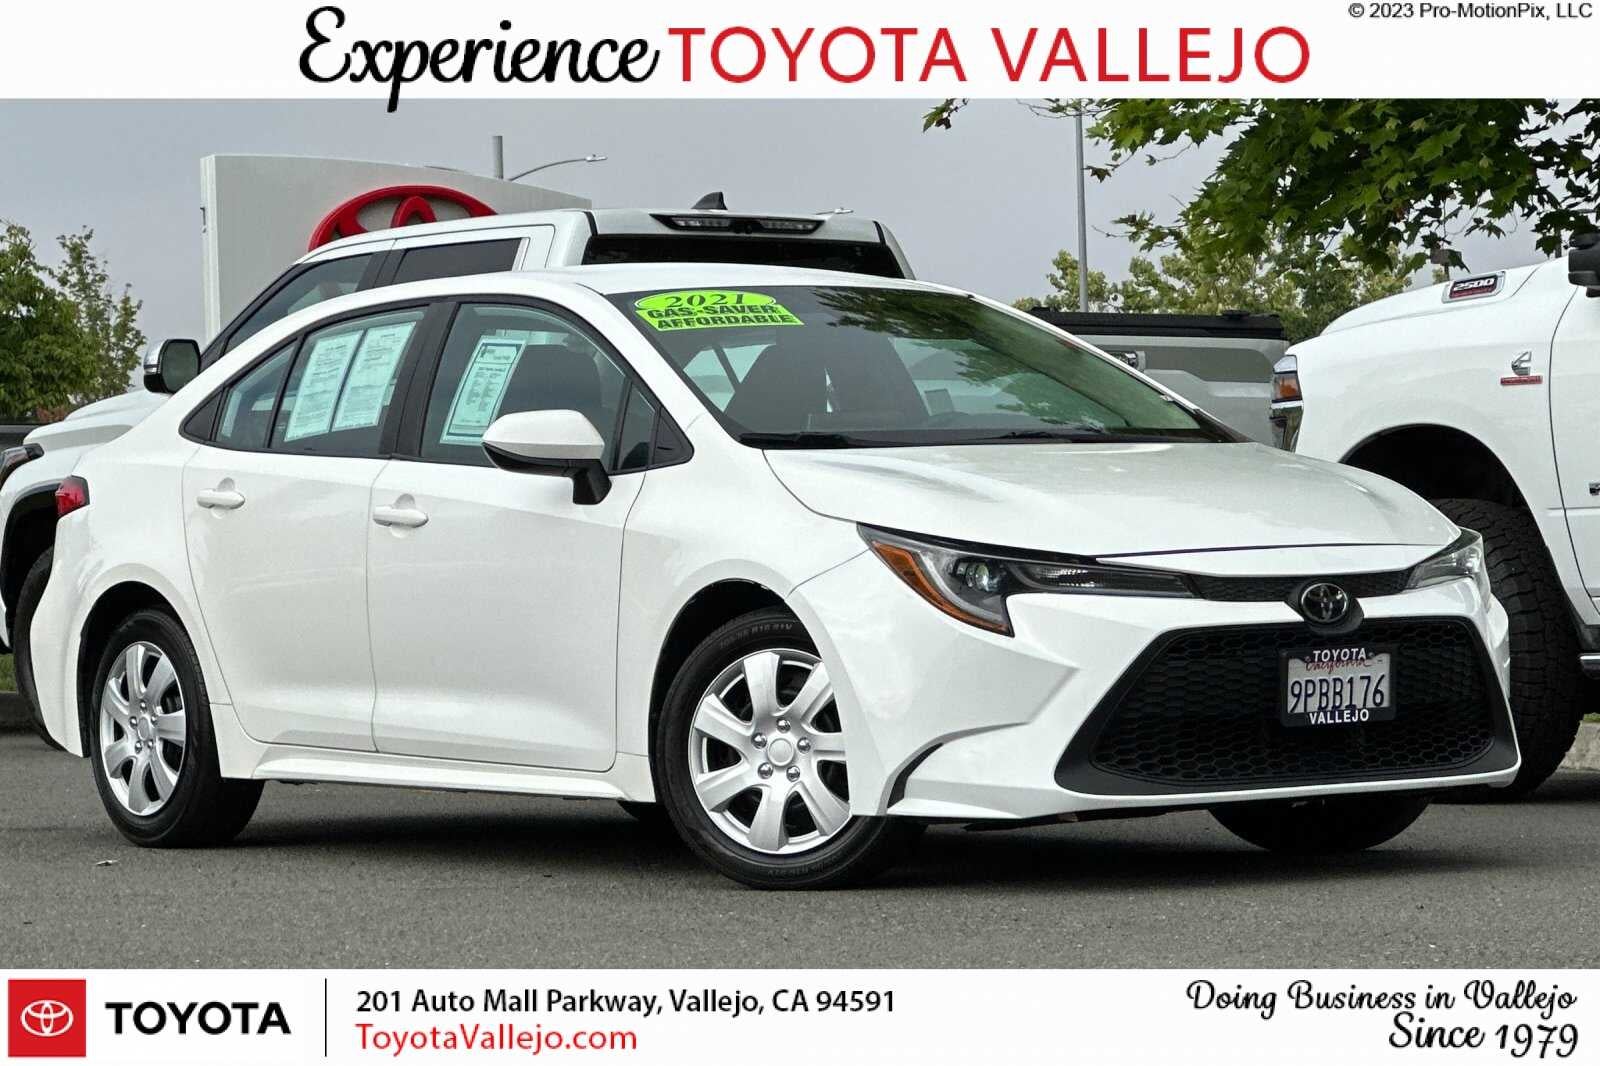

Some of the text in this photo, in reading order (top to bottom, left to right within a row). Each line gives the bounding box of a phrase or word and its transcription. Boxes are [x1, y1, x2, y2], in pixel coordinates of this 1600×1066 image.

[1453, 277, 1496, 291] 2500
[664, 293, 744, 308] 2021
[657, 314, 797, 329] AFFORDABLE
[1313, 648, 1367, 662] TOYOTA
[1290, 674, 1385, 713] 9PBB176
[1309, 709, 1369, 725] VALLEJO
